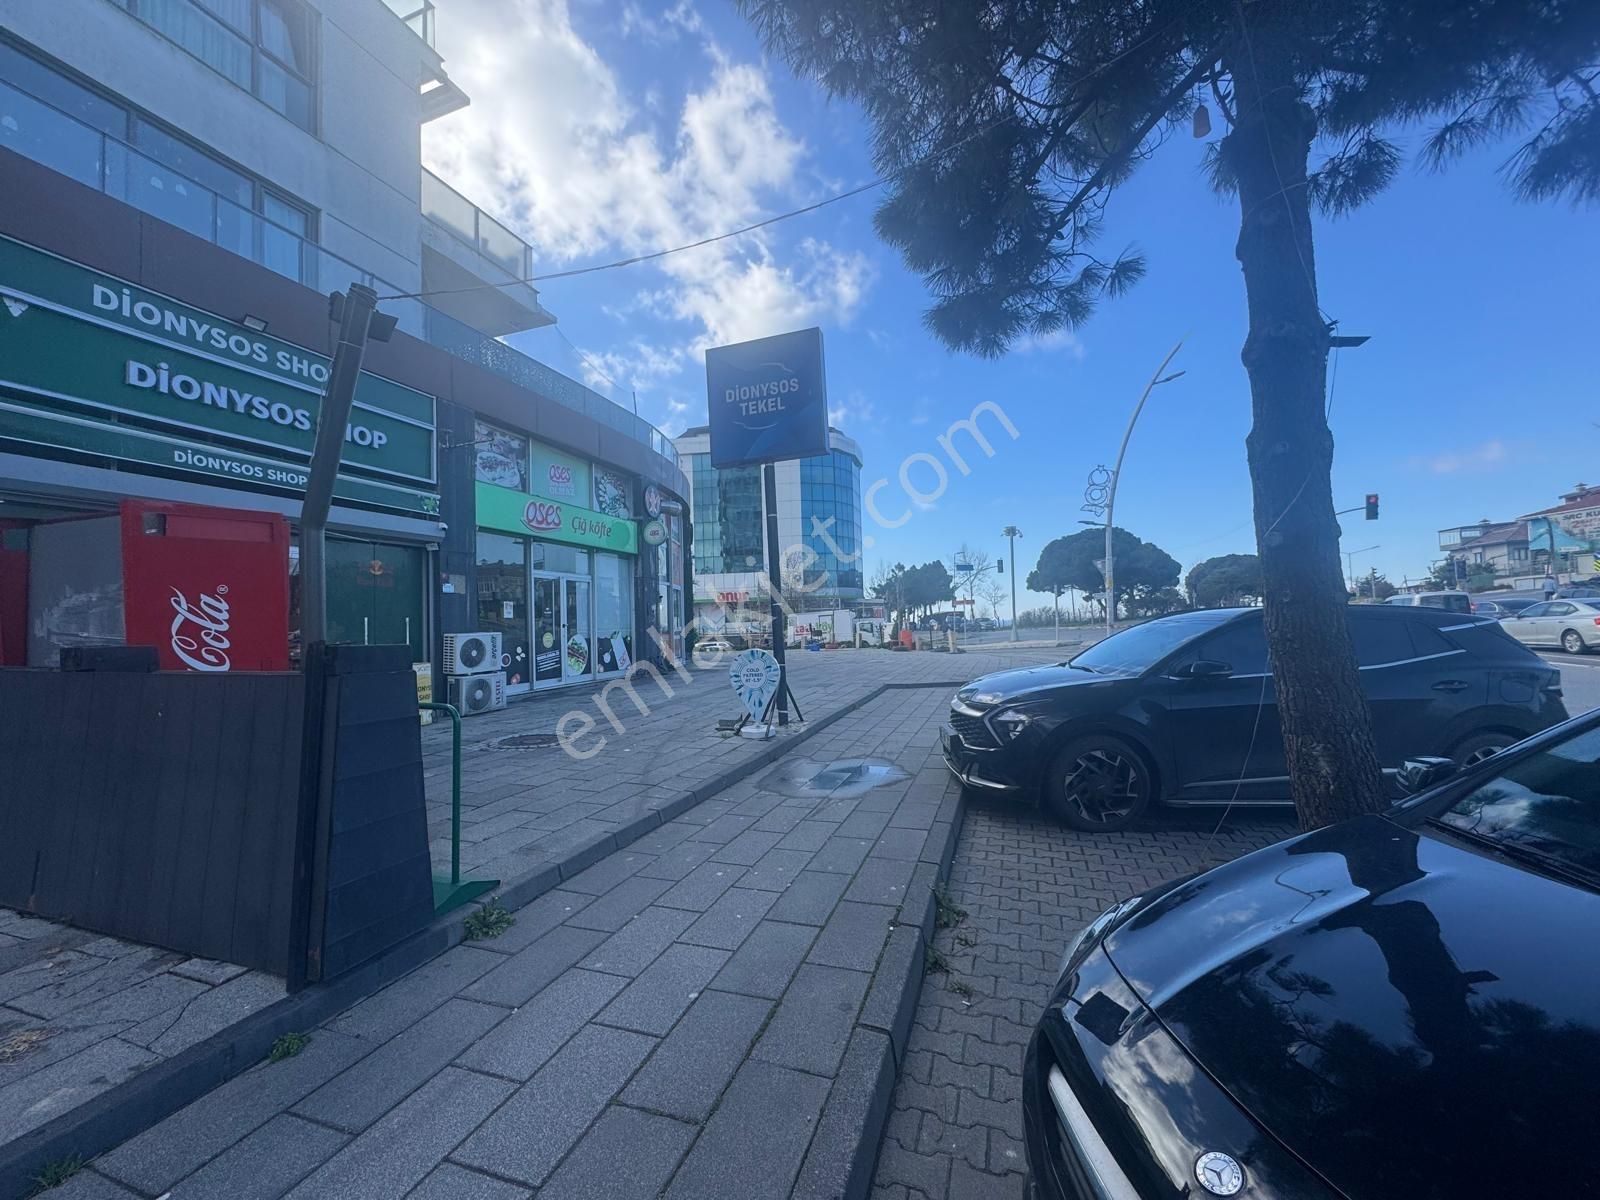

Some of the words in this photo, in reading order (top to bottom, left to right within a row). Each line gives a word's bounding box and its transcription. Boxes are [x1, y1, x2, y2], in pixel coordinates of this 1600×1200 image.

[276, 350, 329, 383] SHO
[739, 396, 786, 417] TEKEL
[345, 423, 388, 449] OP
[267, 469, 308, 486] SHOP
